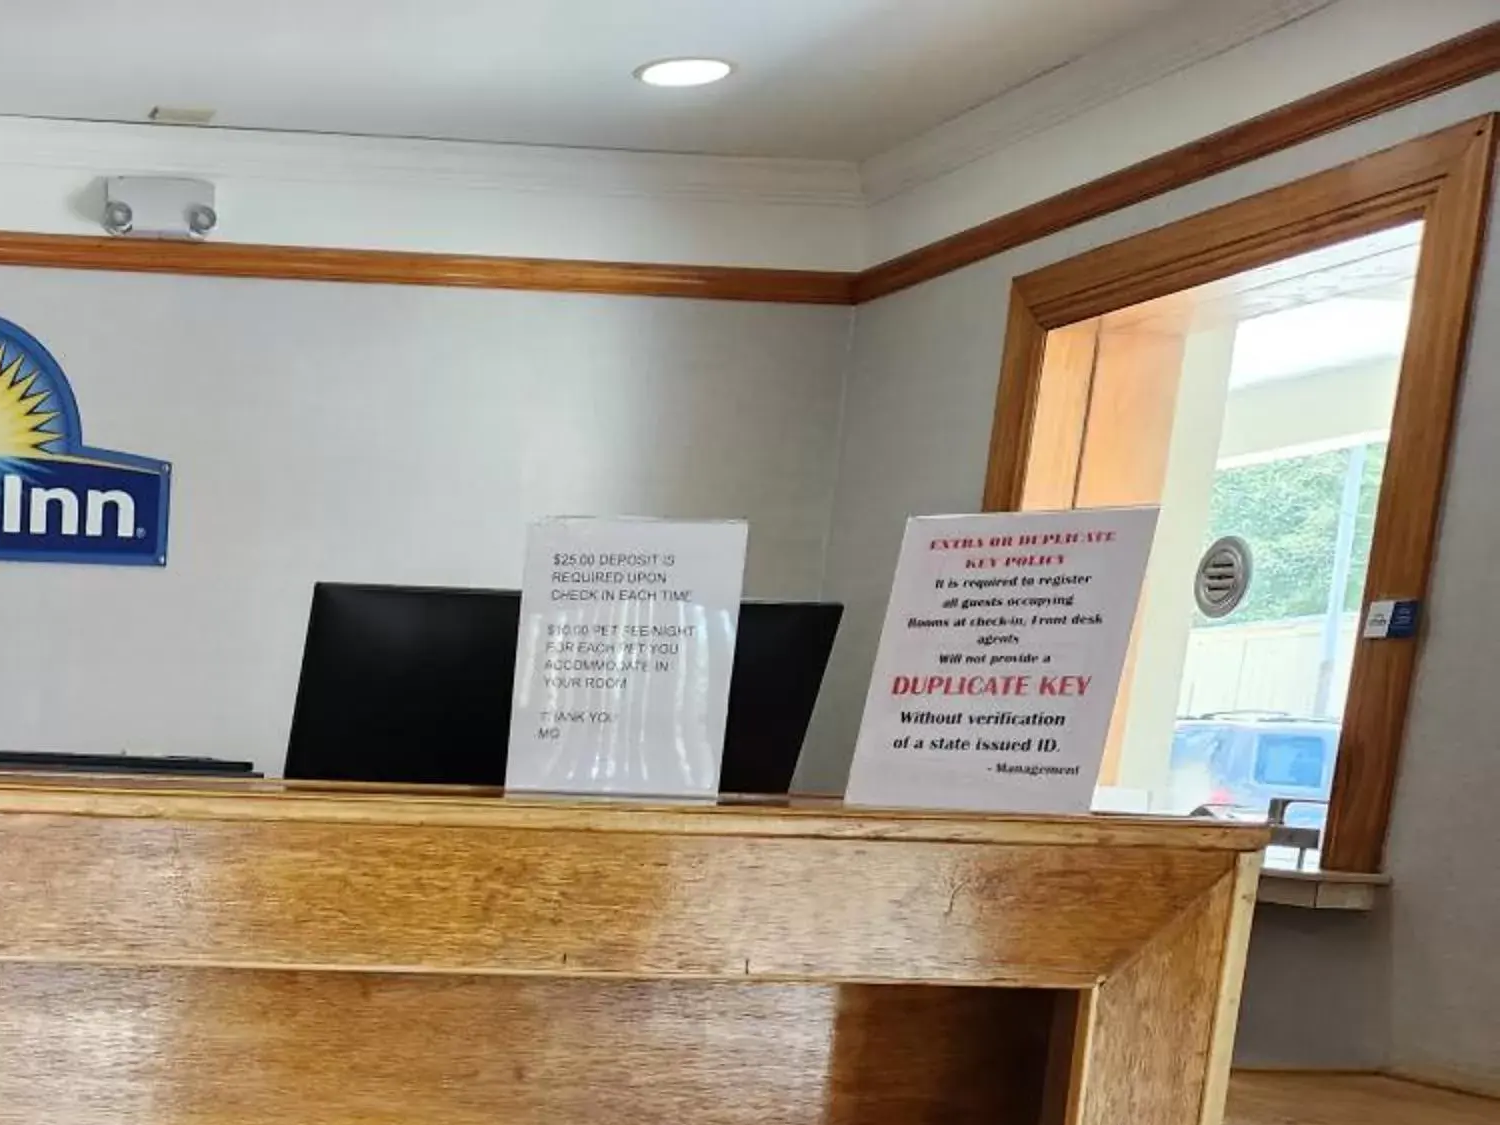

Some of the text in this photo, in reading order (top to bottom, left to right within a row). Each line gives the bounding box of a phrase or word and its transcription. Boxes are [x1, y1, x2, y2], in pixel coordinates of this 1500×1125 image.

[2, 474, 136, 537] Inn
[929, 531, 1116, 550] EXTRA OR DUPLICATE
[599, 553, 657, 567] DEPOSIT
[662, 554, 675, 567] IS
[965, 554, 1066, 569] KEY POLICY
[551, 571, 667, 583] REQUIRED UPON
[935, 574, 1093, 590] It is required to register
[551, 589, 597, 601] CHECK
[601, 589, 615, 601] IN
[618, 589, 657, 601] EACH
[942, 594, 1075, 610] all guests occupying
[907, 617, 949, 629] Rooms
[953, 616, 966, 627] at
[1031, 614, 1067, 626] Front
[1071, 613, 1103, 625] desk
[976, 633, 1020, 646] agents
[577, 642, 615, 654] EACH
[649, 643, 679, 655] YOU
[544, 660, 669, 672] ACCOMMOATE IN
[939, 653, 1051, 666] Will not provide a
[891, 675, 1093, 696] DUPLICATE KEY
[589, 711, 618, 724] YO
[900, 711, 1066, 727] Without verification
[892, 735, 1060, 753] of a state issued ID.
[995, 762, 1080, 777] Management
